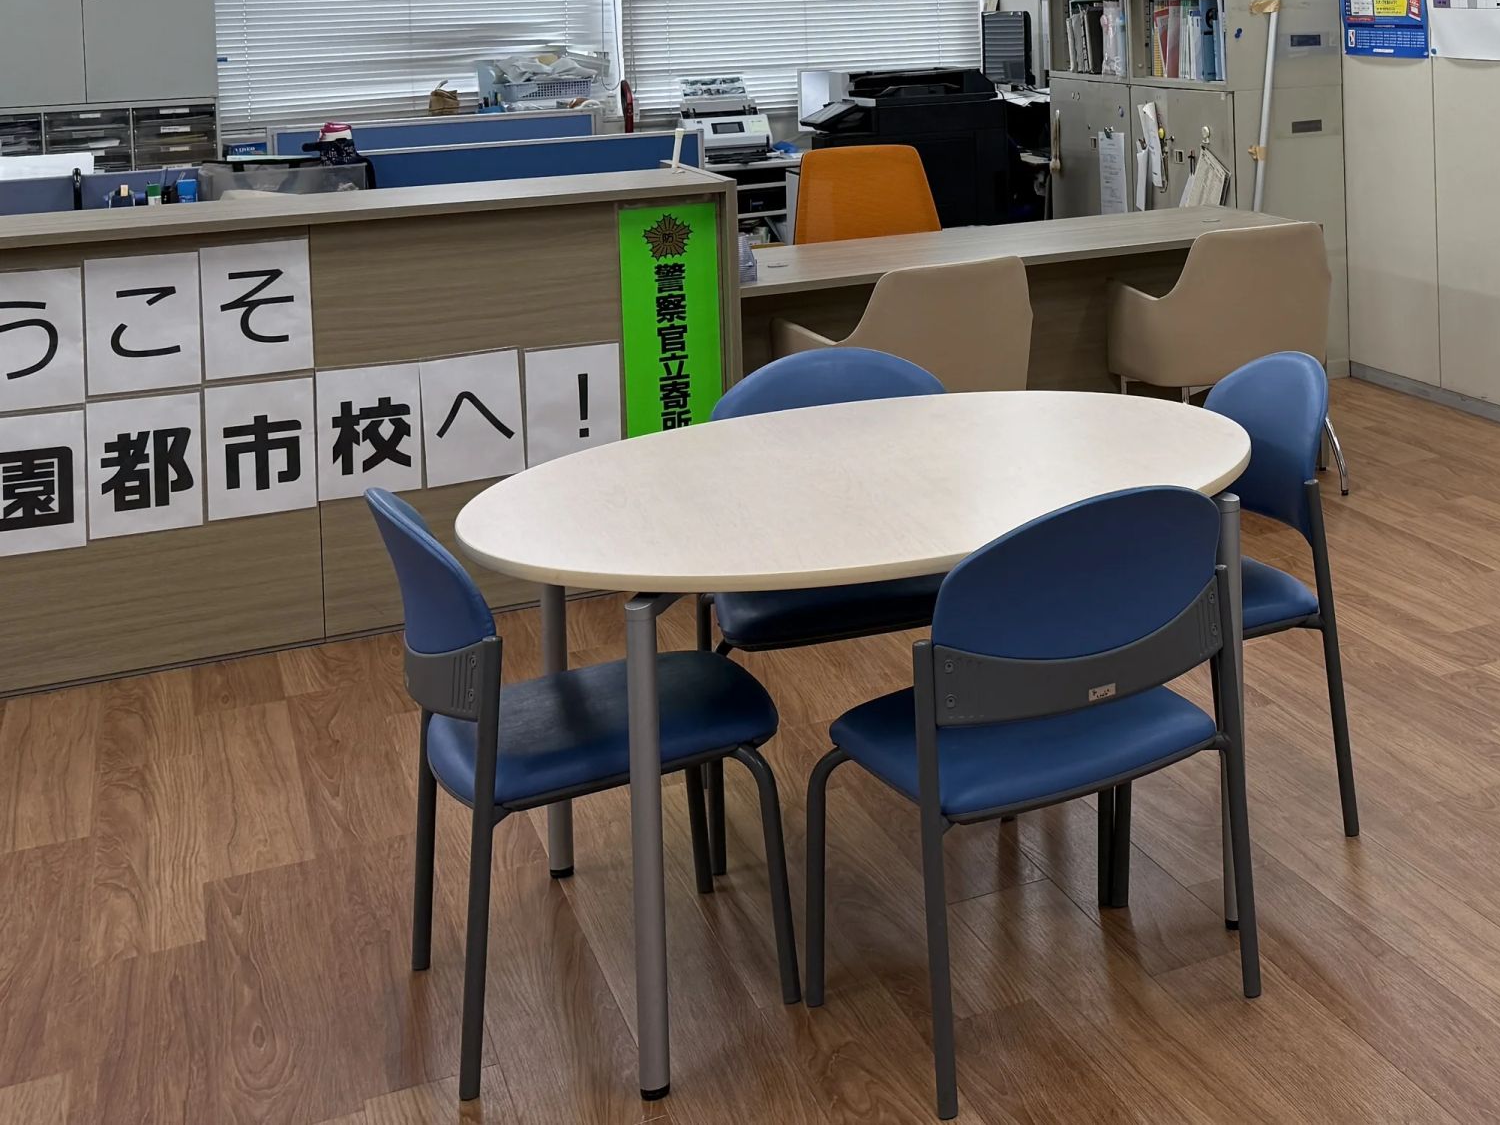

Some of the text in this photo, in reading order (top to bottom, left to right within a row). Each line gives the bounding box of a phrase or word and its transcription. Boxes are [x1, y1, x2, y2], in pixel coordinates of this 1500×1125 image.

[662, 231, 675, 243] 防
[654, 263, 693, 432] 警察官立寄所
[0, 373, 592, 532] 園都市校へ!
